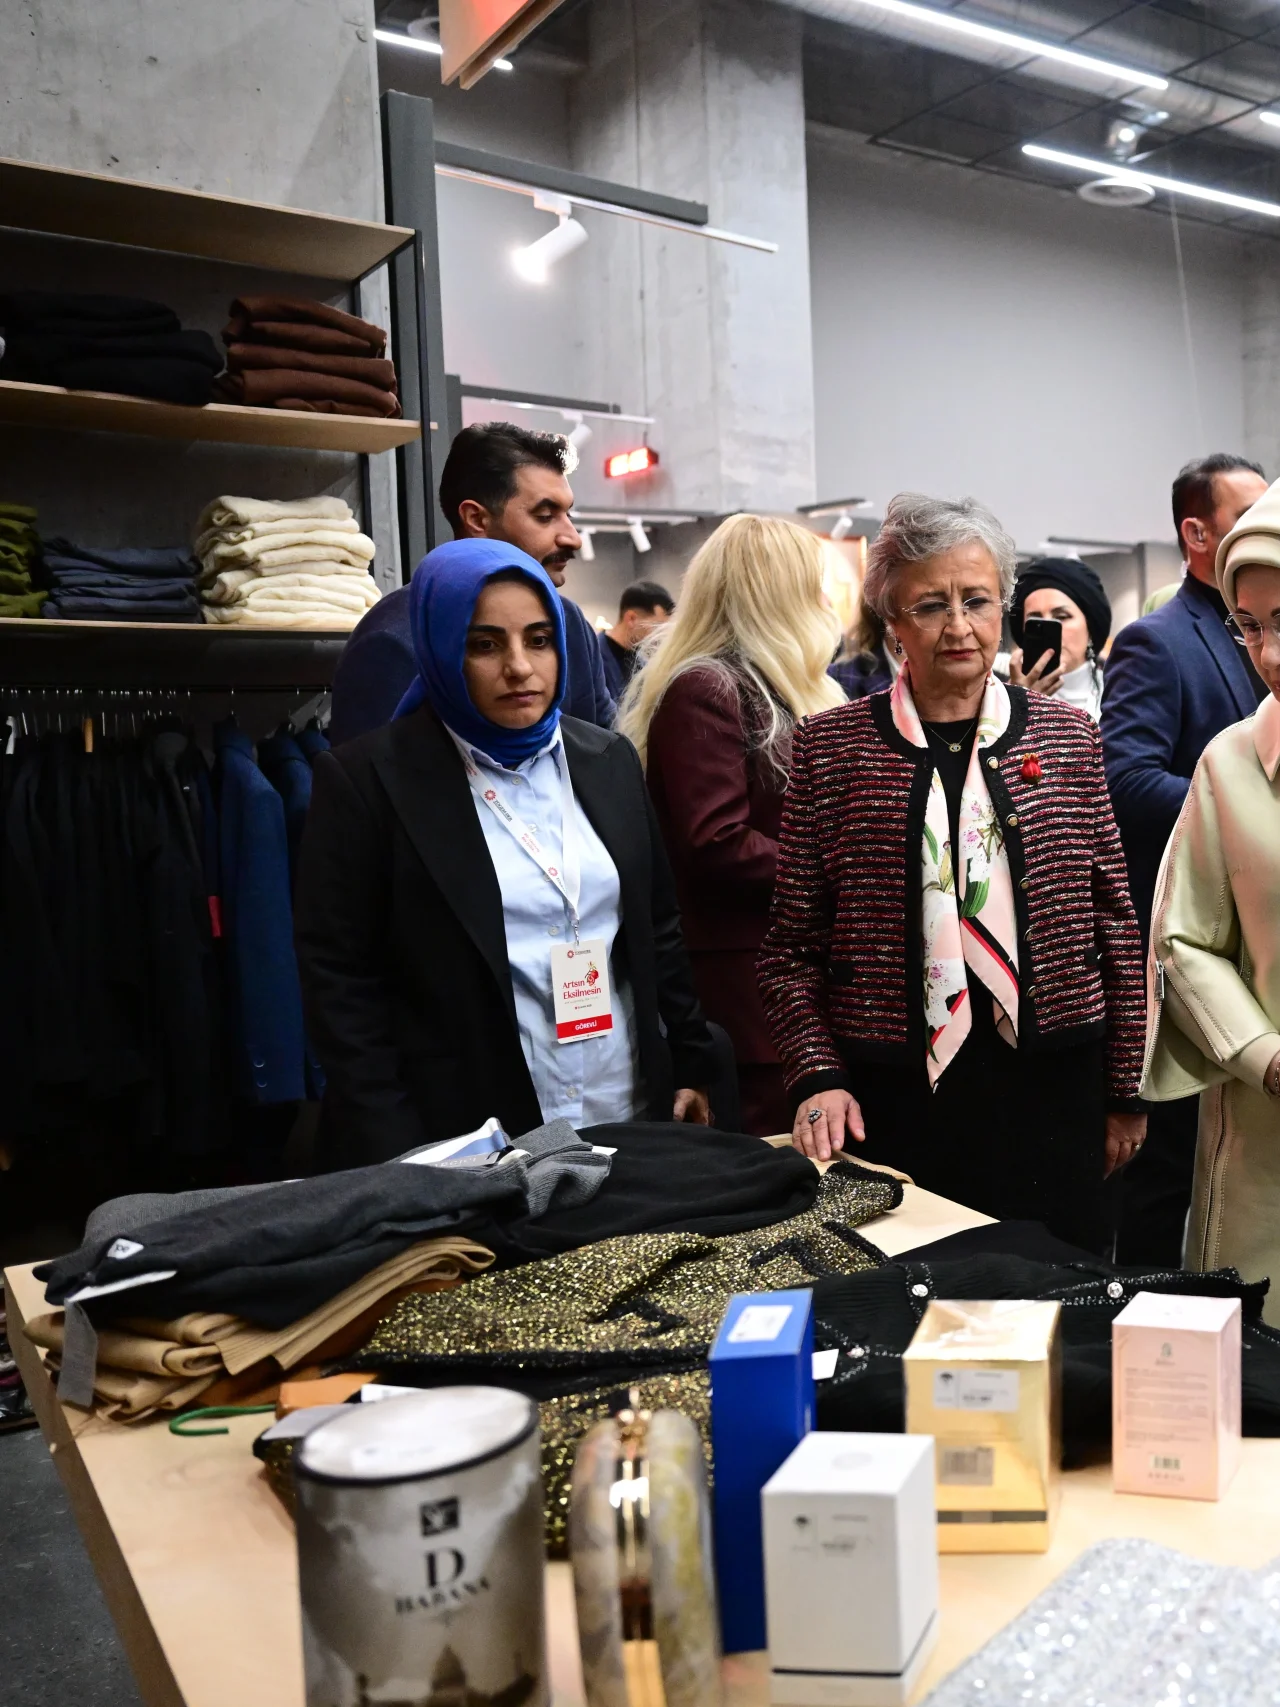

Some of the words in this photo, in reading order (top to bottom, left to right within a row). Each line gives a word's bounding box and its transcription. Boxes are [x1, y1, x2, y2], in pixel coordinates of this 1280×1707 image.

[562, 980, 585, 989] Artsın
[563, 986, 602, 1000] Eksilmesin
[426, 1546, 465, 1589] D
